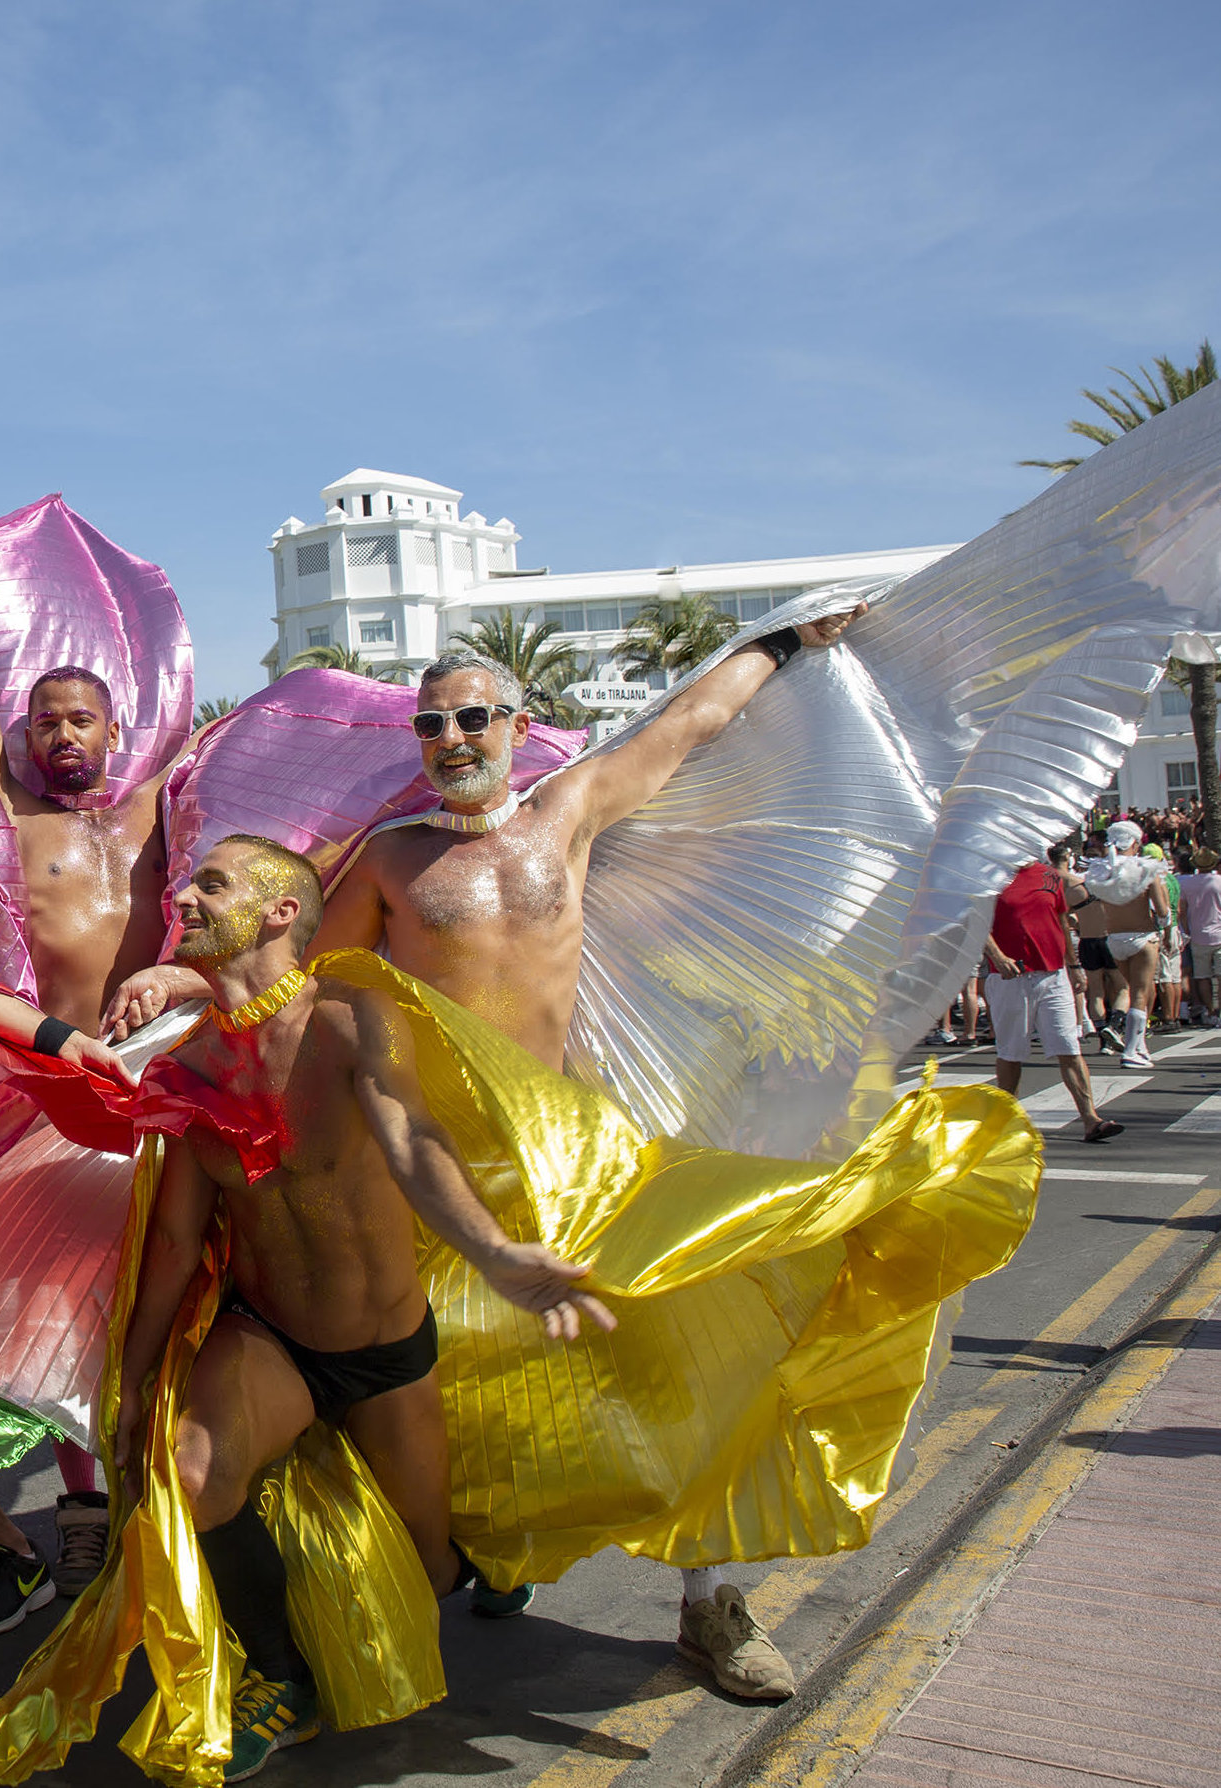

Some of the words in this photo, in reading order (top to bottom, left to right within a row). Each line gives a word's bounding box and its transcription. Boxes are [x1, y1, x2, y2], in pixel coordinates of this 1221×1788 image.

[581, 688, 594, 700] AV.
[596, 689, 606, 700] de
[608, 689, 647, 700] TIRAJANA
